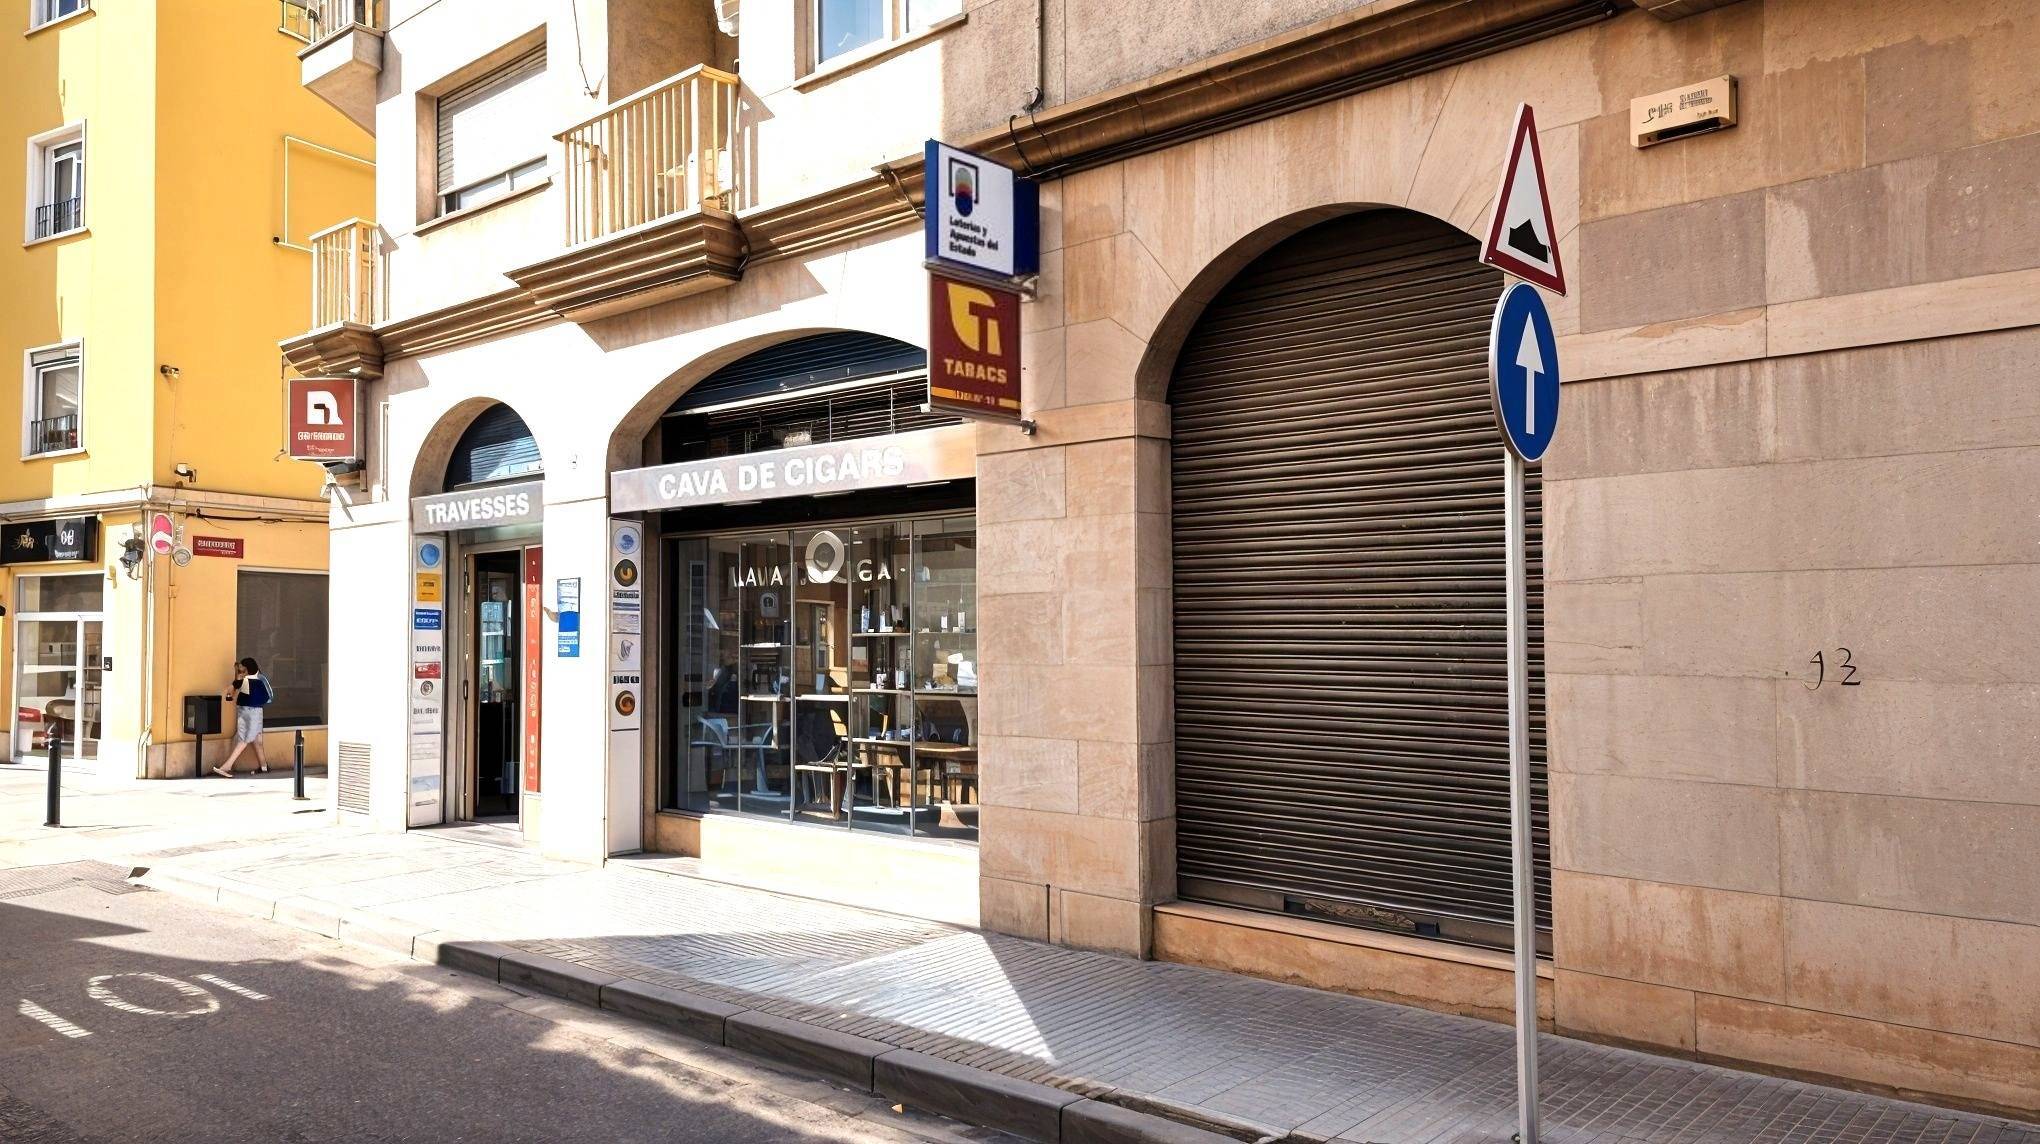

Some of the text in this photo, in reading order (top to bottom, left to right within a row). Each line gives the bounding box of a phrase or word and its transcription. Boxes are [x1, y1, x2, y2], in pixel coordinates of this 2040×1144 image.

[949, 241, 977, 257] Estado
[943, 358, 1008, 384] TABACS
[658, 447, 905, 500] CAVA DE CIGARS
[425, 492, 530, 524] TRAVESSES
